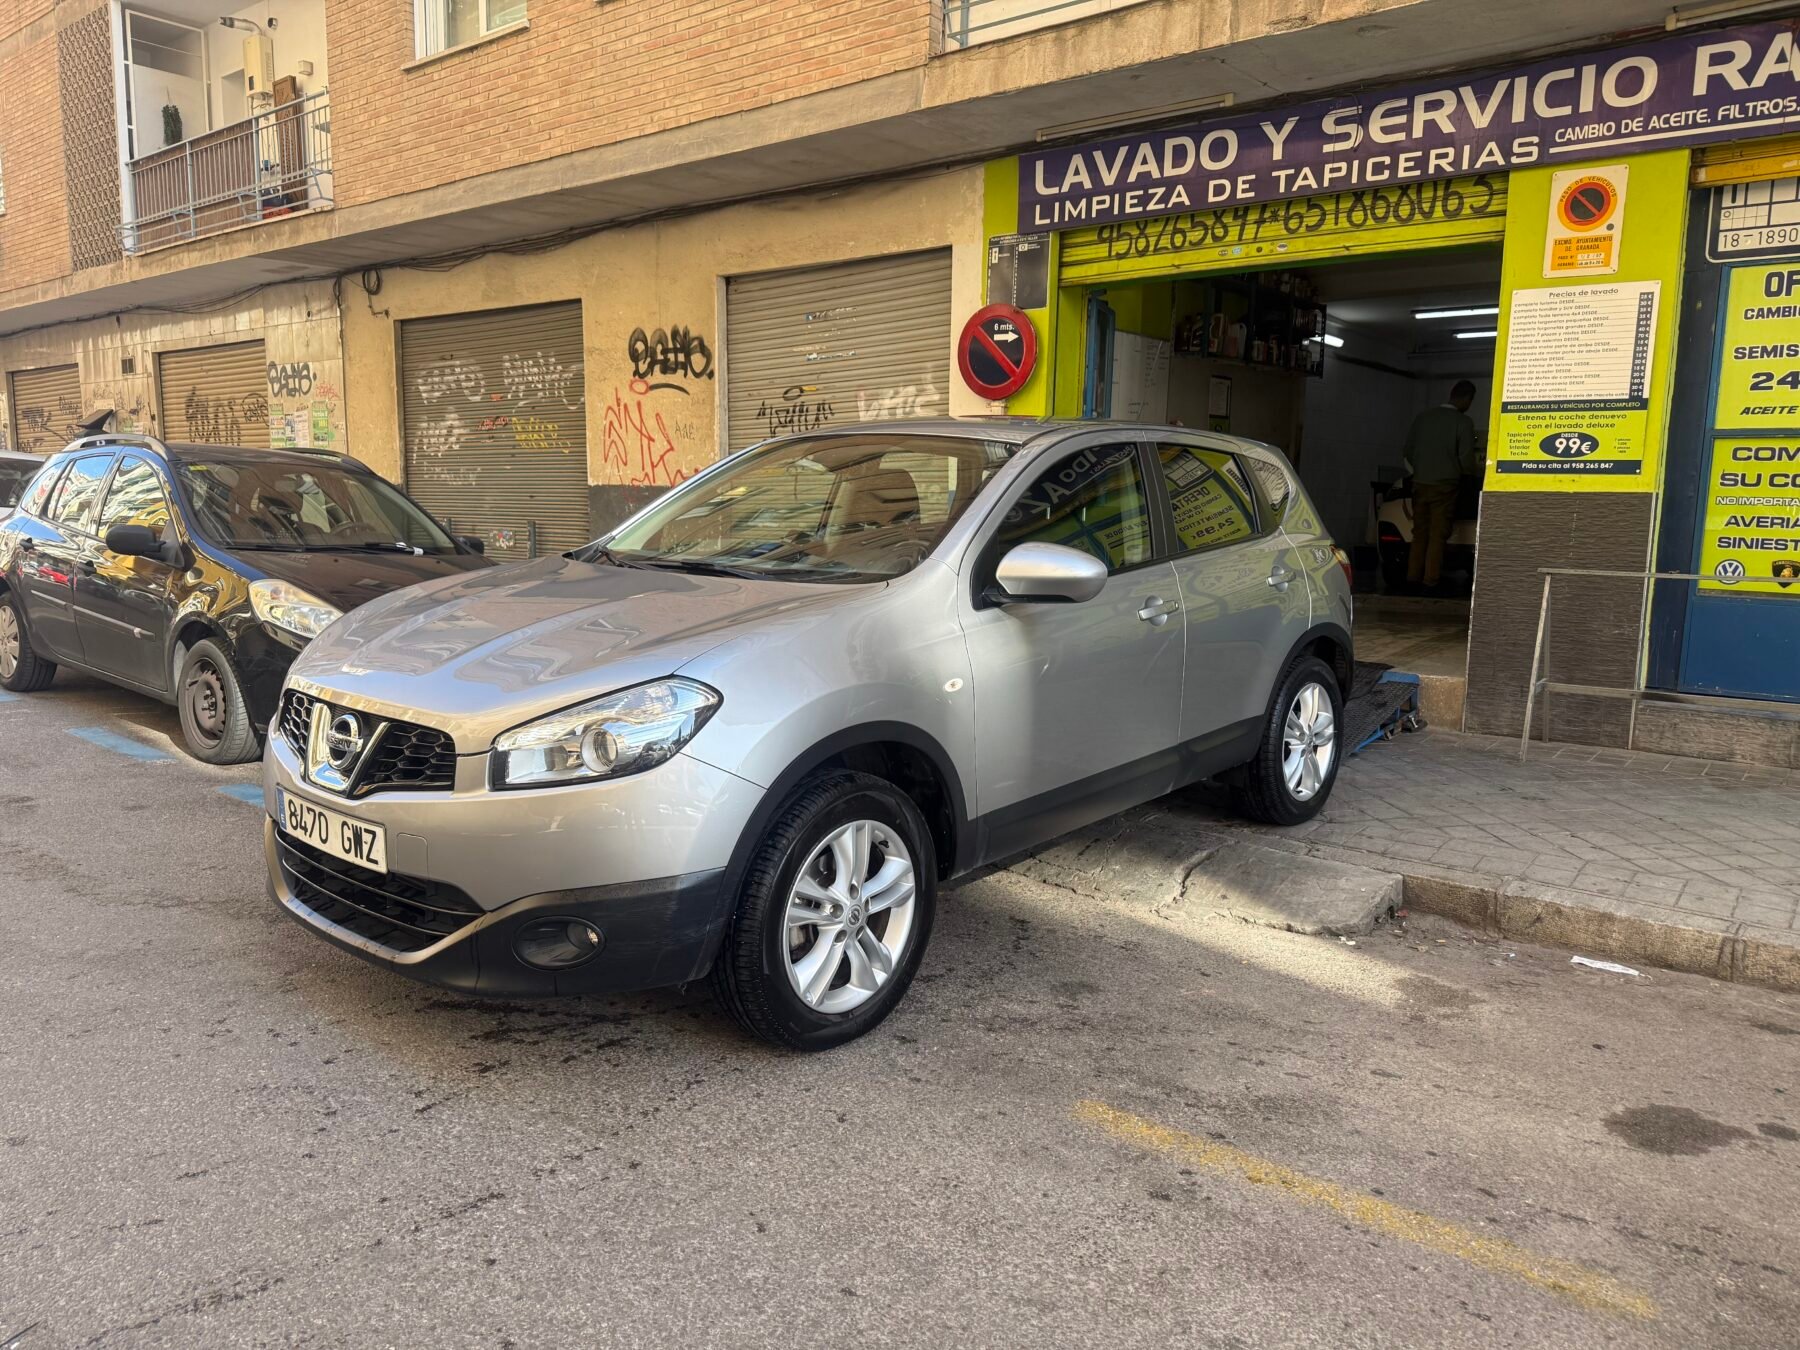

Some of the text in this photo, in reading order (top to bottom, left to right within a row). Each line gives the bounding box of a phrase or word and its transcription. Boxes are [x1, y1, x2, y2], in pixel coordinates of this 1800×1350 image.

[1034, 31, 1800, 196] LAVADO Y SERVICIO RA
[1555, 121, 1616, 143] CAMBIO
[1621, 117, 1644, 134] DE
[1648, 108, 1711, 130] ACEITE,
[1035, 135, 1540, 226] LIMPIEZA DE TAPICERIAS
[1590, 288, 1619, 296] lavado
[1744, 305, 1800, 320] CAMBI
[1740, 405, 1799, 415] ACEITE
[1555, 438, 1591, 454] 99€
[1720, 472, 1762, 487] SU
[1715, 496, 1737, 505] NO
[288, 798, 379, 866] 8470 GWZ
